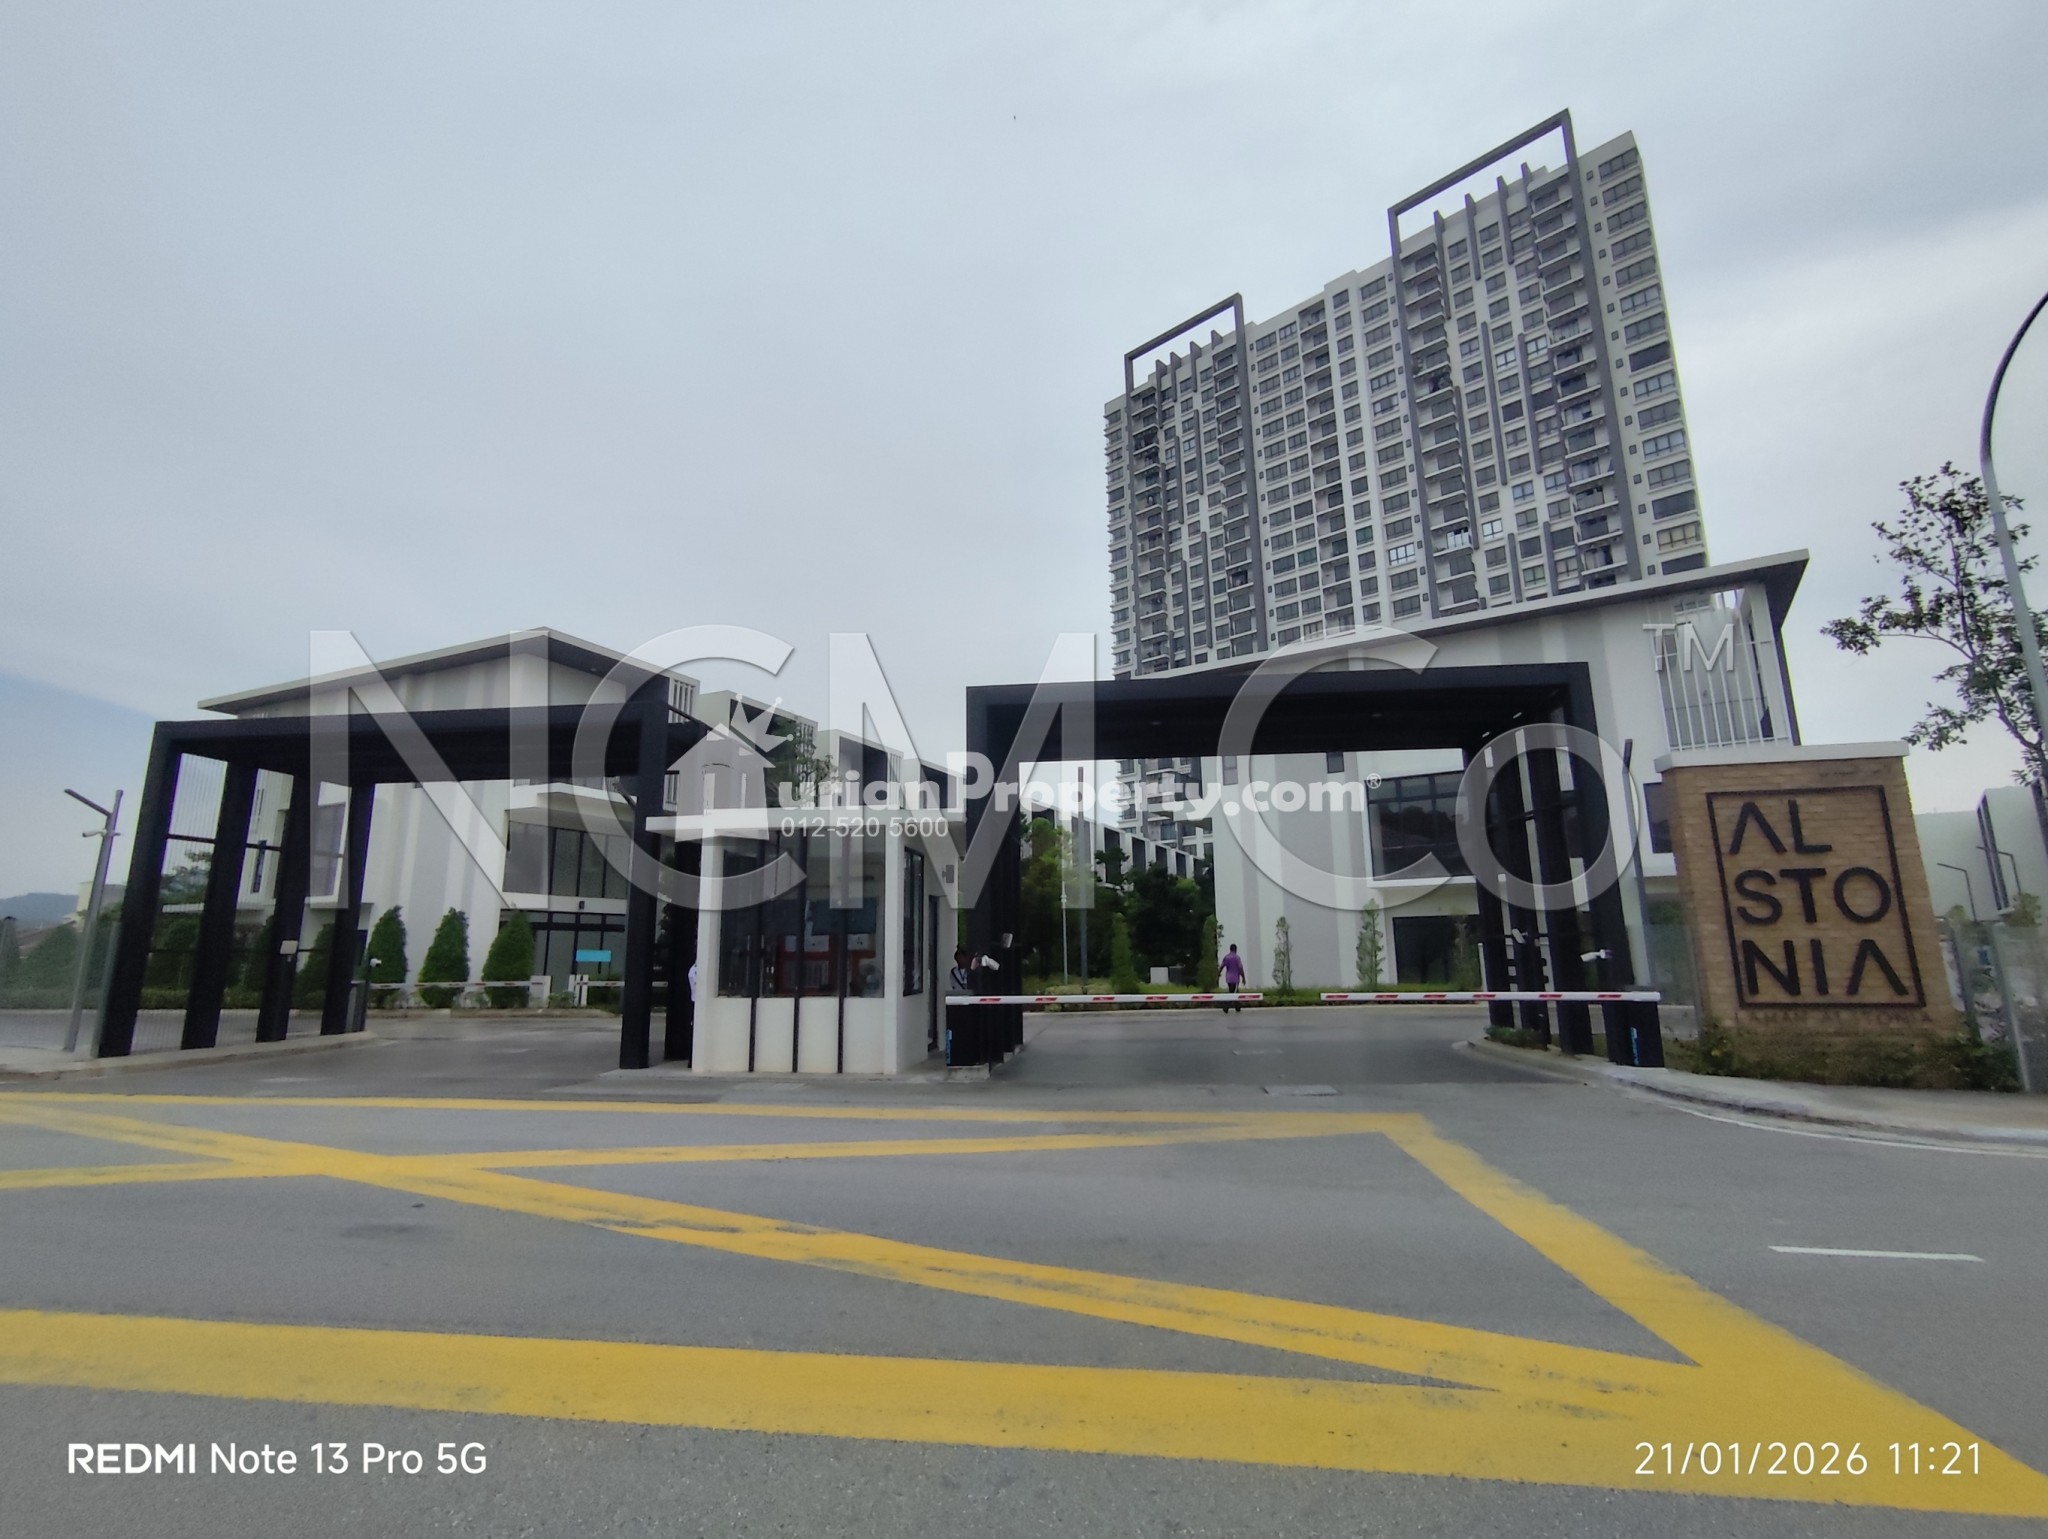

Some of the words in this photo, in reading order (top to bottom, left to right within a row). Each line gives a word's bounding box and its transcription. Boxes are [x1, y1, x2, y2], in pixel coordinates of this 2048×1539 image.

[1729, 799, 1833, 855] AL
[1735, 866, 1892, 926] STO
[1742, 938, 1909, 996] NIA
